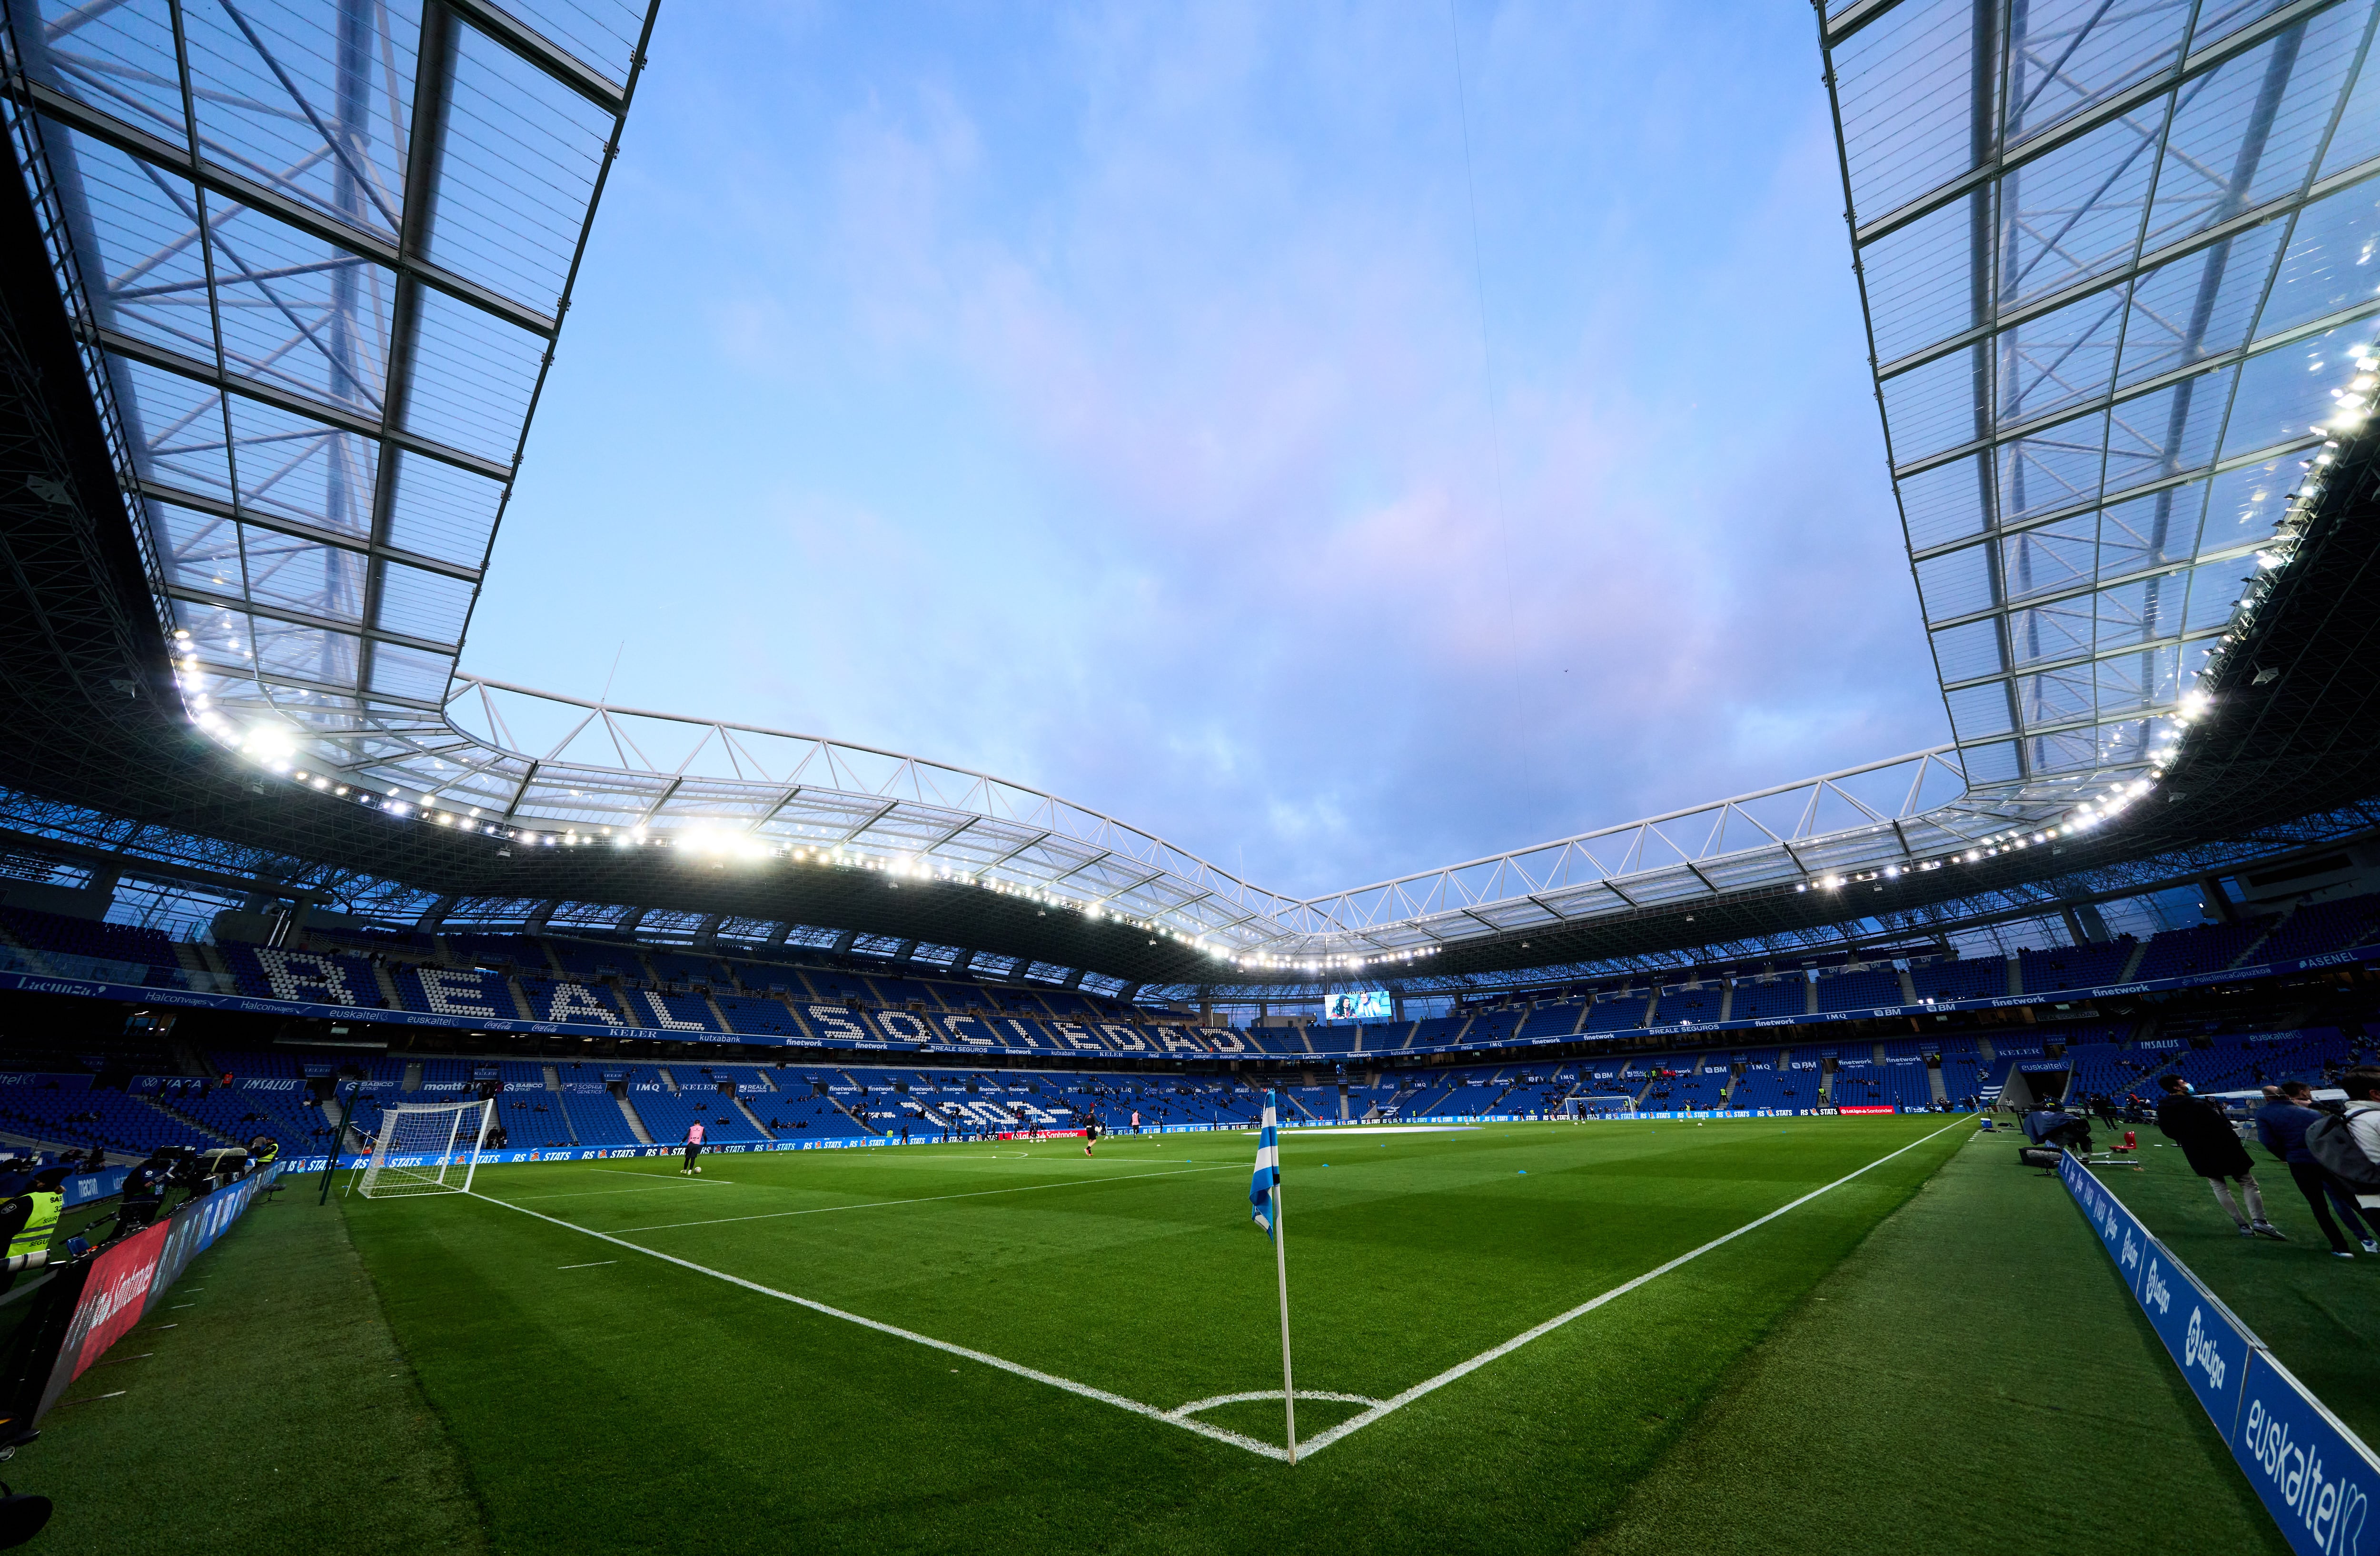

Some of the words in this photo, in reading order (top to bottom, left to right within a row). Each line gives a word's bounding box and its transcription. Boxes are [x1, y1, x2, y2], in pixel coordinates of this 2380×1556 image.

[2308, 952, 2359, 968] ASENEL
[2092, 984, 2151, 997] finetwork
[1992, 995, 2046, 1007] finetwork
[1938, 1003, 1955, 1011] BM
[329, 1010, 380, 1020] euskaltel
[407, 1016, 452, 1026] euskaltel
[1755, 1018, 1795, 1027] finetwork
[609, 1028, 657, 1038] KELER
[1681, 1024, 1719, 1032] SEGUROS
[699, 1034, 741, 1043] kutxabank
[2249, 1030, 2294, 1042] euskaltel
[786, 1038, 823, 1047] finetwork
[855, 1042, 888, 1050] finetwork
[2141, 1039, 2180, 1049] INSALUS
[1999, 1048, 2041, 1057] KELER
[2021, 1062, 2062, 1071] euskaltel
[242, 1079, 298, 1090] INSALUS
[1046, 1130, 1078, 1138] Santander
[754, 1144, 764, 1152] RS
[776, 1142, 796, 1151] STATS
[803, 1142, 813, 1150] RS
[823, 1140, 843, 1148] STATS
[868, 1138, 885, 1147] STATS
[581, 1150, 595, 1159] RS
[610, 1148, 636, 1158] STATS
[645, 1147, 656, 1157] RS
[671, 1146, 686, 1155] STA
[724, 1144, 746, 1153] STATS
[477, 1154, 501, 1164] TATS
[511, 1153, 526, 1163] RS
[543, 1151, 572, 1161] STATS
[287, 1160, 298, 1172] RS
[351, 1158, 370, 1169] RS
[389, 1157, 423, 1167] STATS
[78, 1177, 99, 1198] macron
[2153, 1274, 2171, 1315] LaLiga
[2197, 1329, 2226, 1390] LaLiga
[2245, 1399, 2346, 1556] euskaltel
